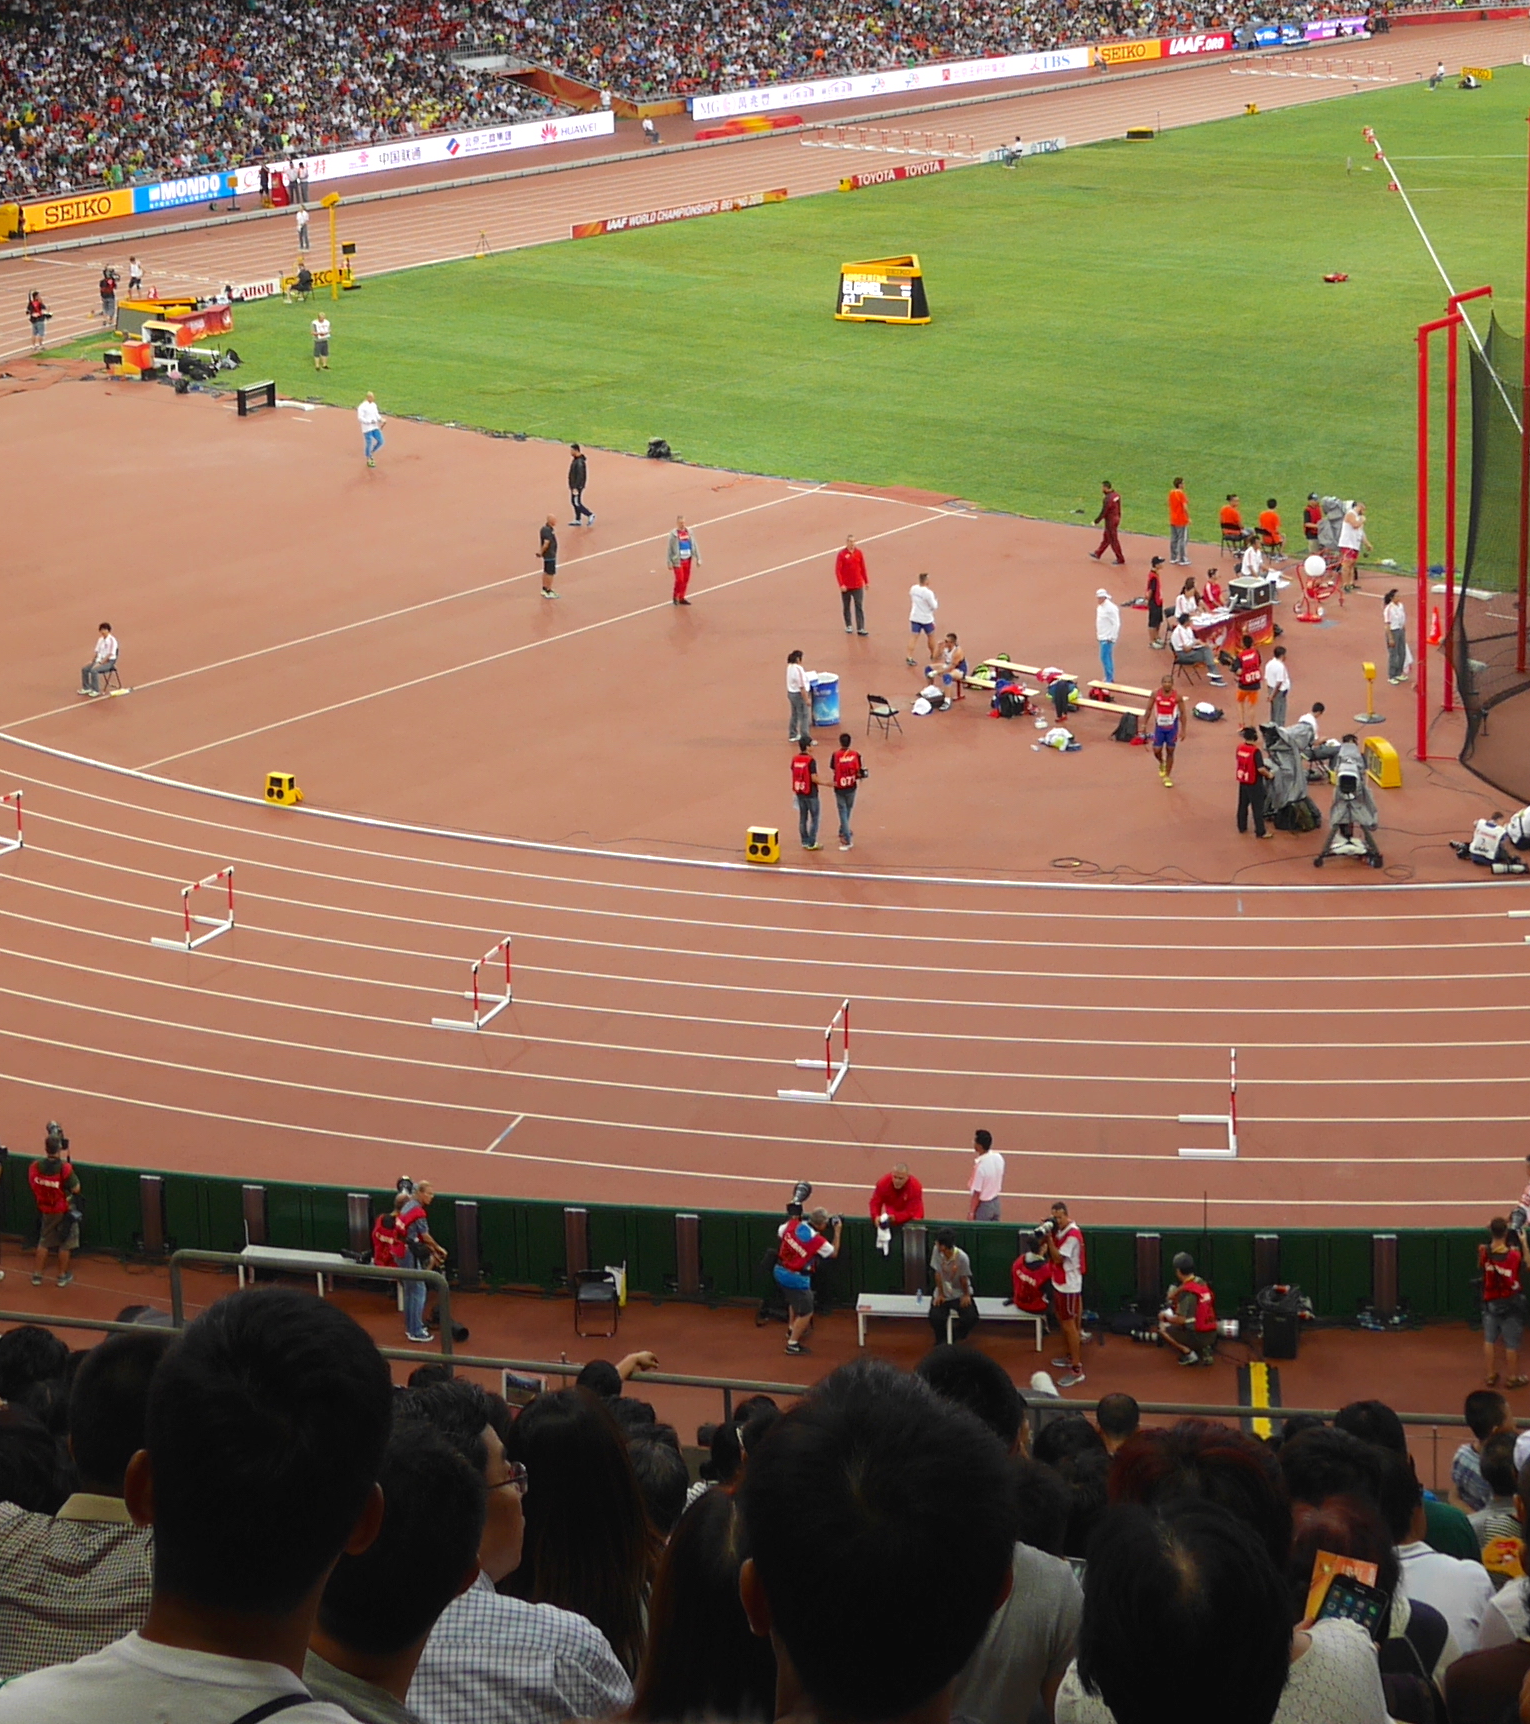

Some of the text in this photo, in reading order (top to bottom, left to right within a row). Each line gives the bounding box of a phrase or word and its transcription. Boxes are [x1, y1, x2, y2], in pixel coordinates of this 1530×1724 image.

[1101, 44, 1146, 61] SEIKO
[1169, 34, 1224, 55] IAAF.ORG
[1040, 55, 1070, 69] TBS
[700, 100, 719, 115] MG
[561, 123, 597, 136] HUAWEI
[379, 147, 421, 165] 中国联通
[857, 161, 941, 186] TOYOTA TOYOTA
[160, 174, 220, 200] MONDO
[45, 196, 111, 225] SEIKO
[606, 219, 629, 231] IAAF
[629, 212, 657, 227] WORLD
[657, 201, 719, 222] CHAMPIONSHIPS
